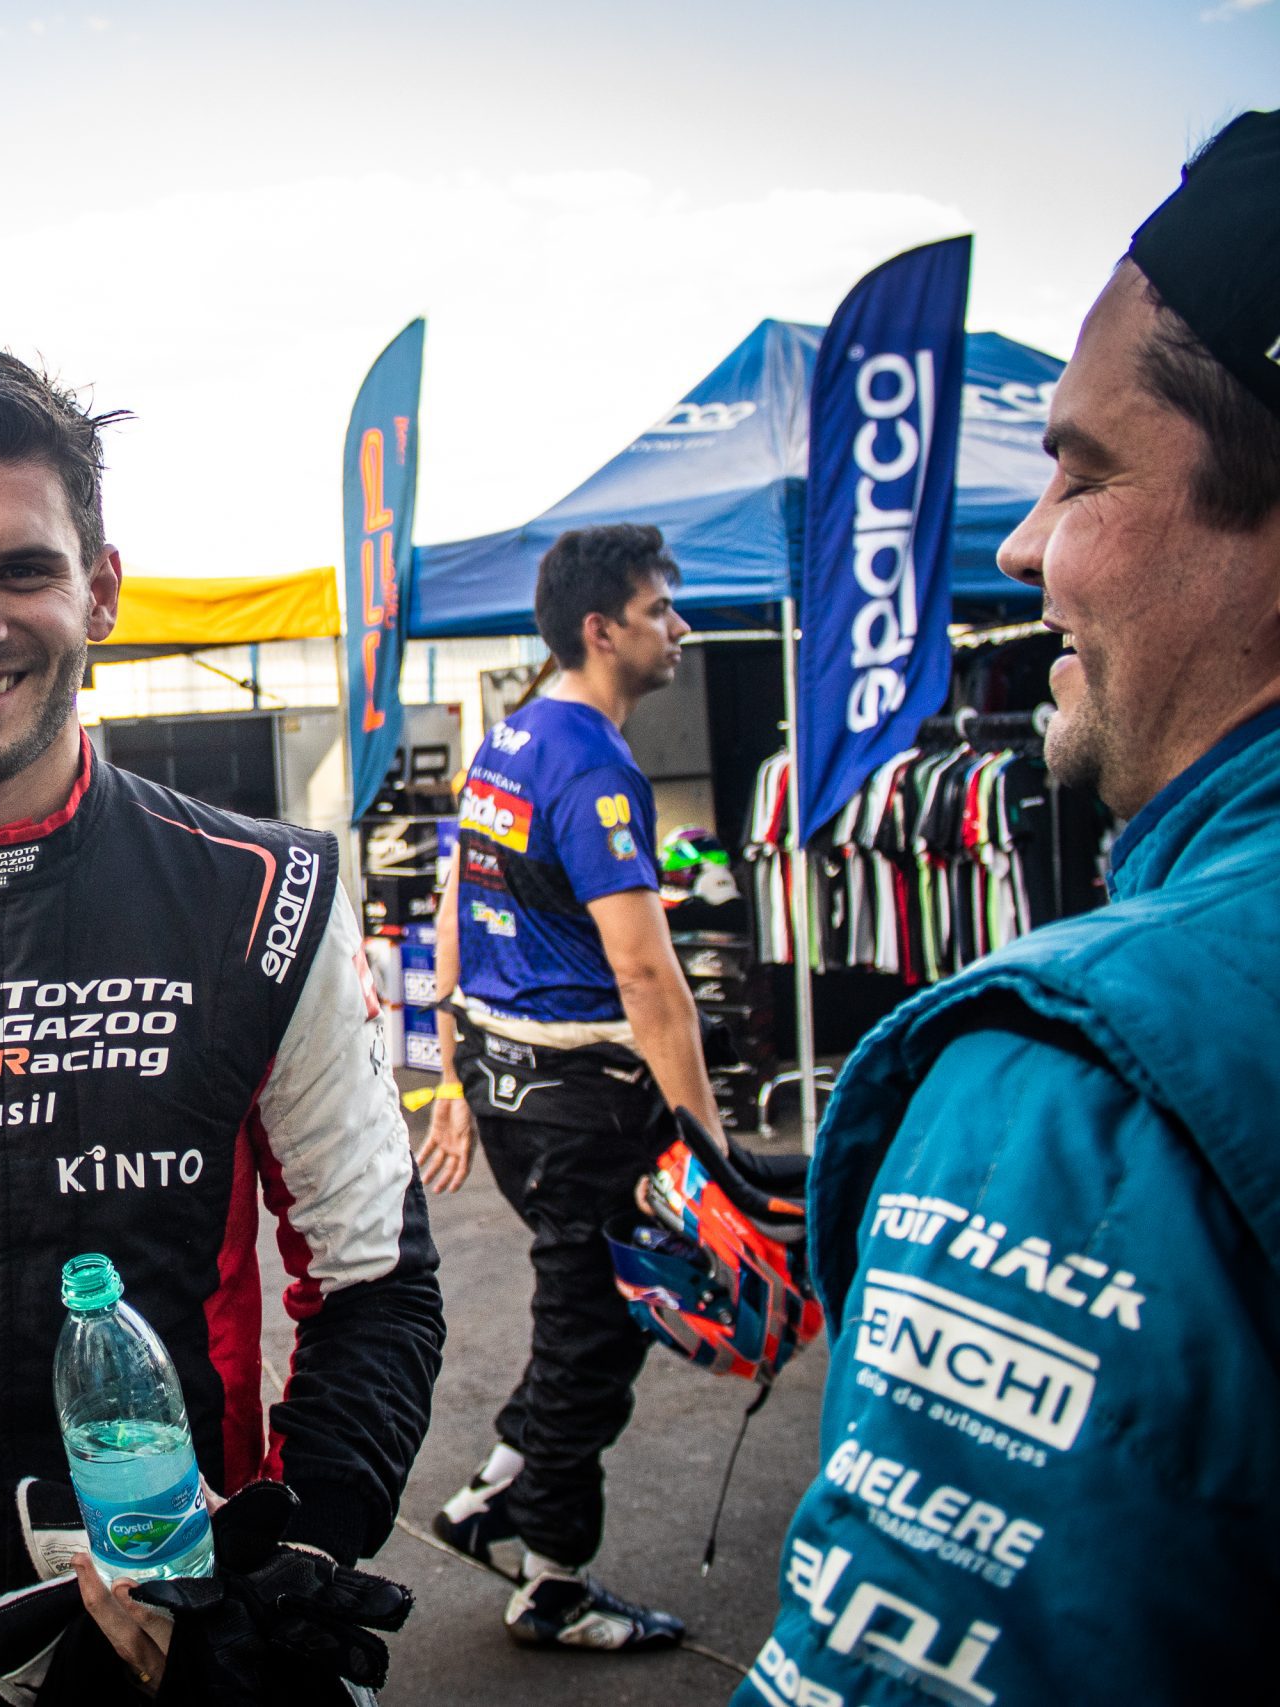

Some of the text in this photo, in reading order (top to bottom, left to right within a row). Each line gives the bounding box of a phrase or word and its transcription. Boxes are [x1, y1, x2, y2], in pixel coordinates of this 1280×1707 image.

[847, 352, 919, 733] sparco
[596, 794, 631, 828] 90
[261, 846, 317, 980] sparco
[0, 978, 193, 1009] TOYOTA
[56, 1145, 203, 1194] KINTO
[892, 1385, 924, 1411] de
[928, 1400, 1048, 1468] autopeças
[113, 1520, 154, 1534] crystal
[869, 1506, 1018, 1589] TRANSPORTES
